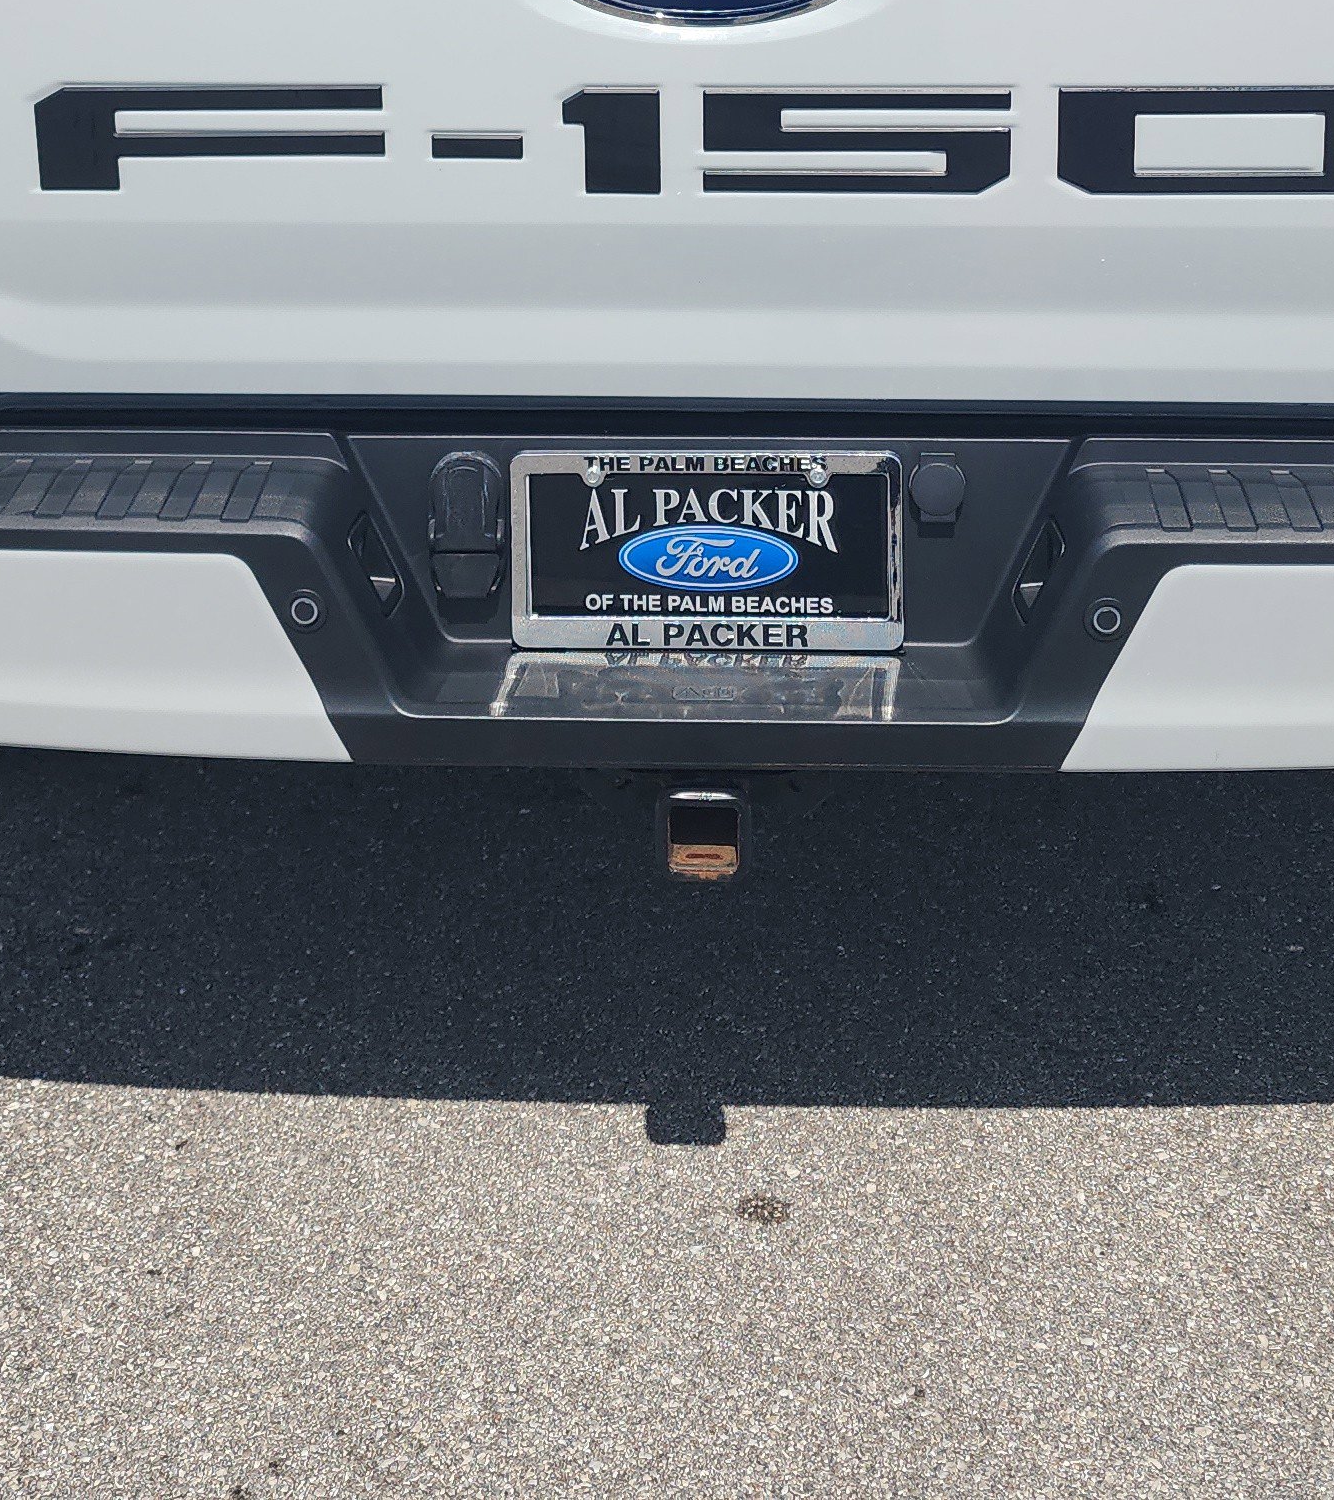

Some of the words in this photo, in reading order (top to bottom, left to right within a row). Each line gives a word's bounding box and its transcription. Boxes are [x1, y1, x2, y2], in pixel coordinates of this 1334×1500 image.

[584, 456, 631, 472] THE
[639, 456, 704, 472] PALM
[713, 456, 828, 472] BEACHES
[579, 488, 641, 551] AL
[652, 488, 838, 554] PACKER
[655, 535, 760, 579] Ford
[585, 594, 614, 611] OF
[620, 594, 662, 612] THE
[668, 596, 725, 613] PALM
[731, 597, 834, 614] BEACHES
[605, 622, 651, 647] AL
[662, 622, 809, 647] PACKER
